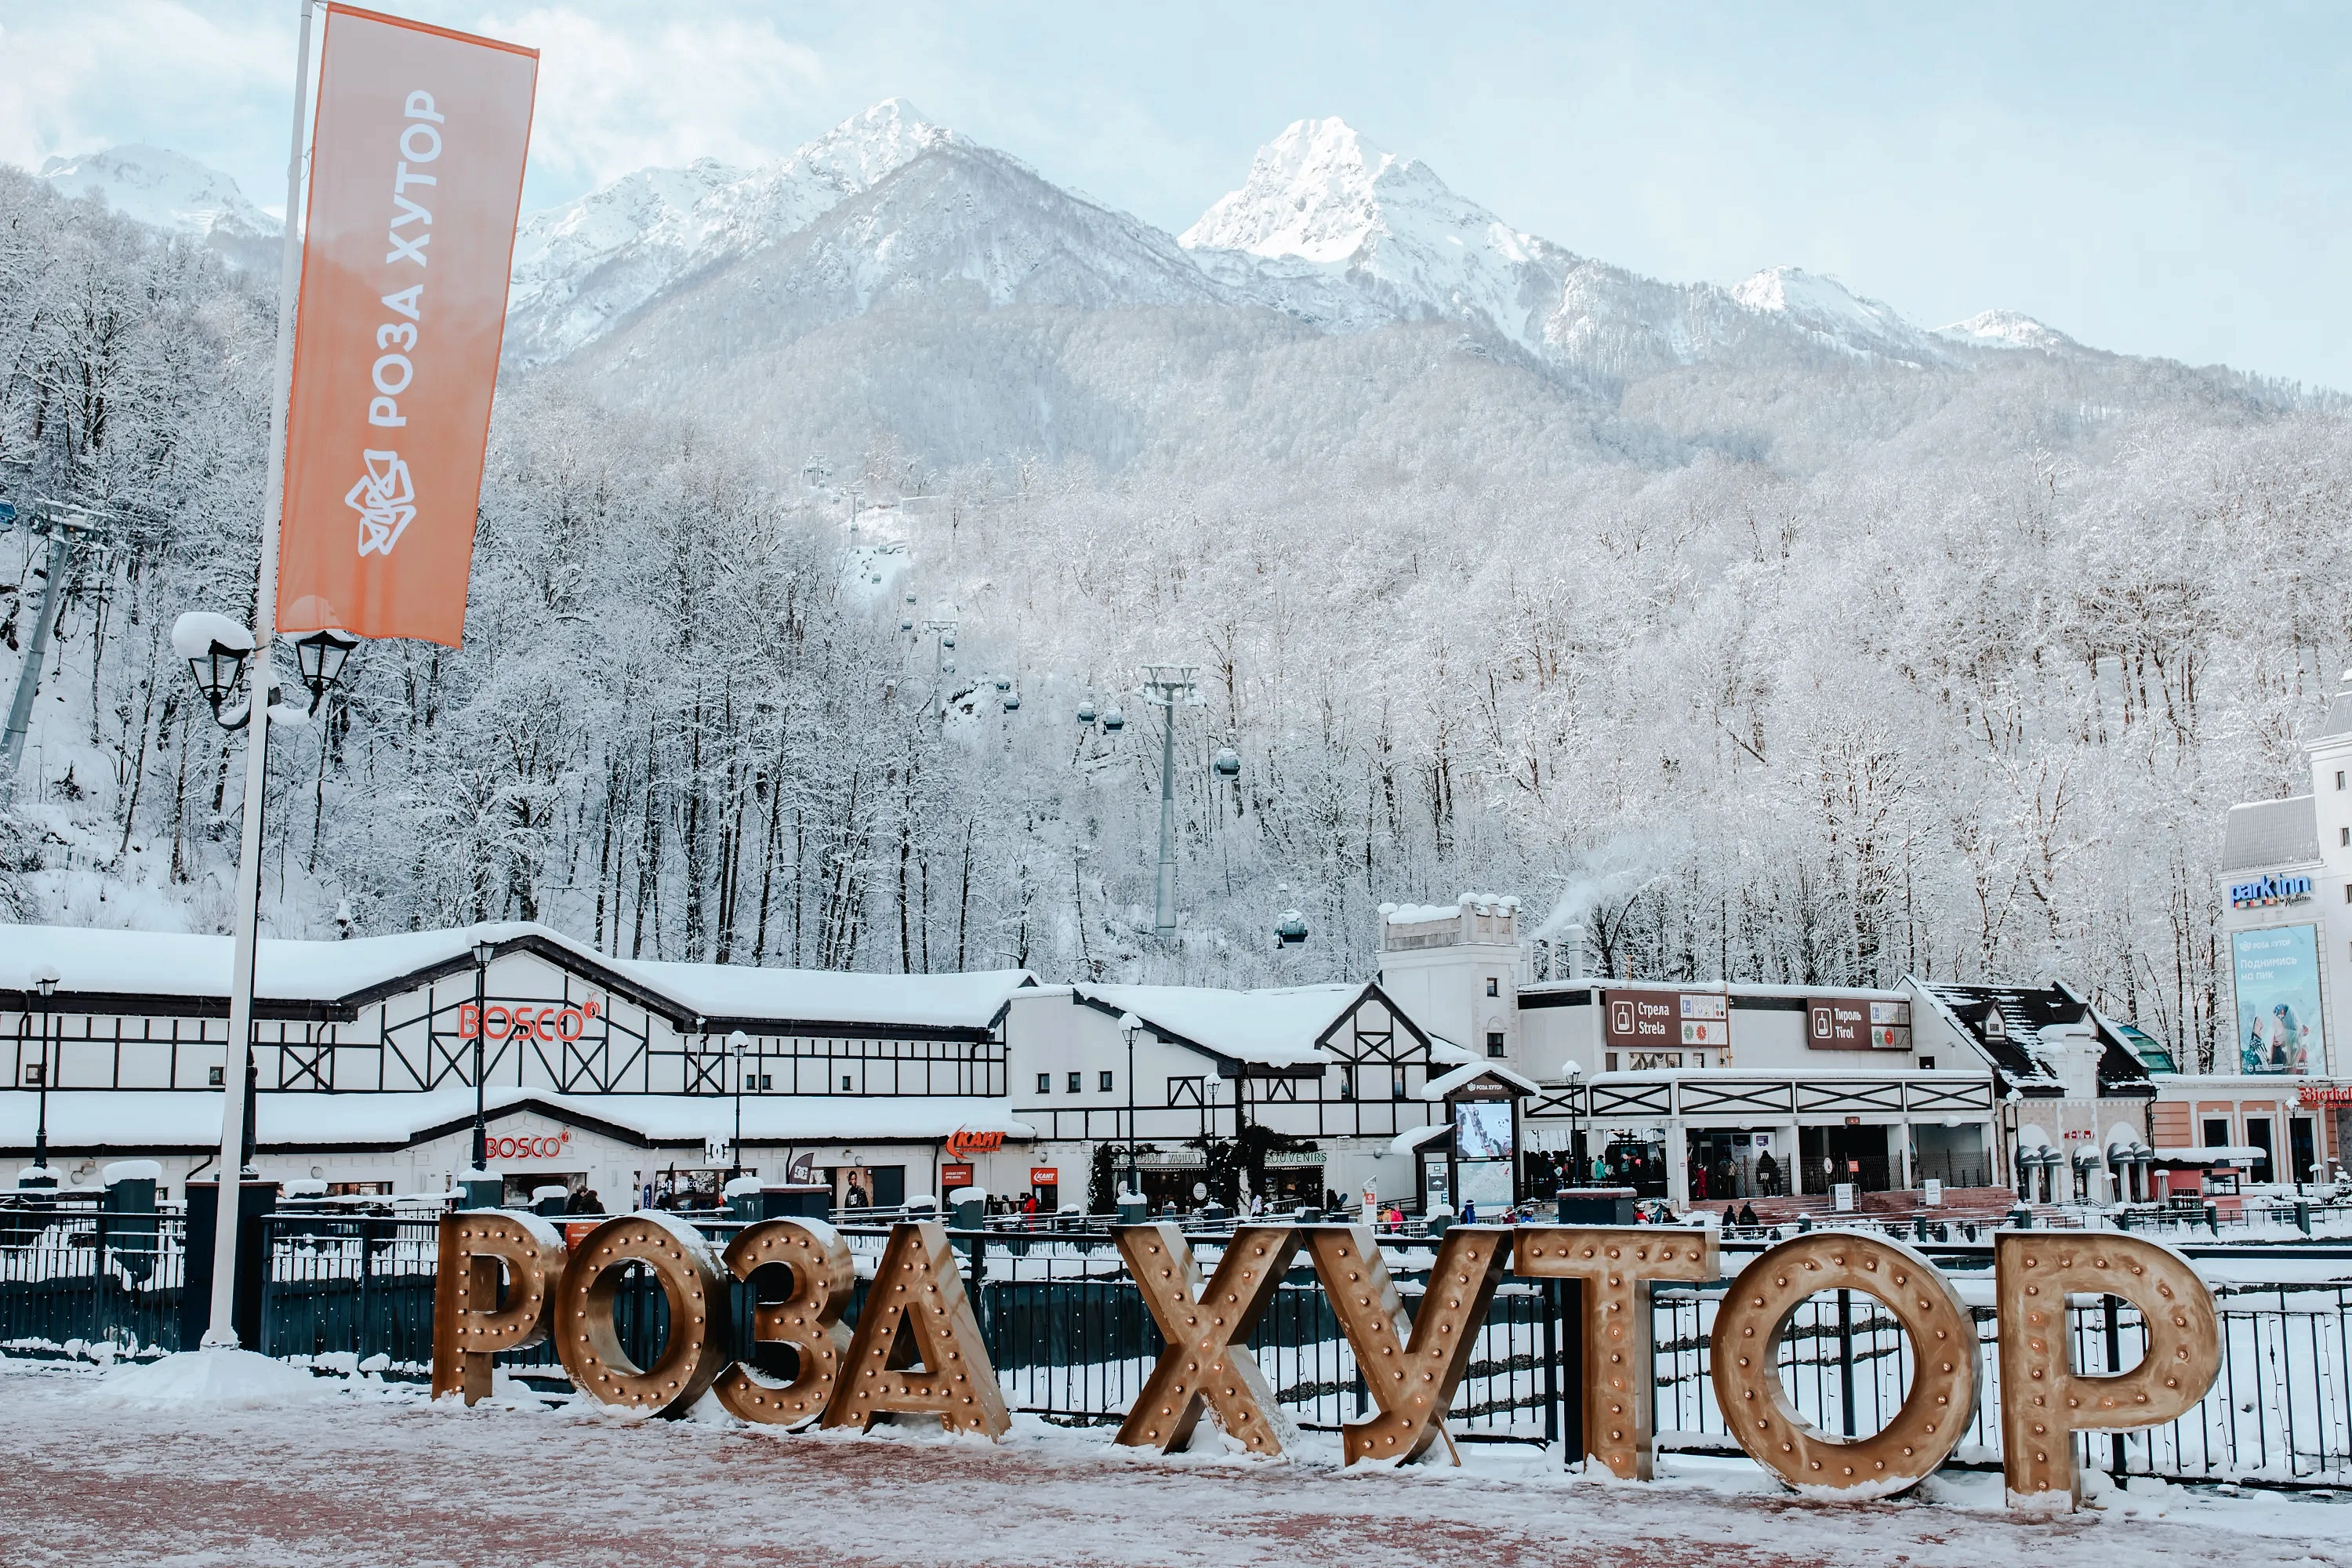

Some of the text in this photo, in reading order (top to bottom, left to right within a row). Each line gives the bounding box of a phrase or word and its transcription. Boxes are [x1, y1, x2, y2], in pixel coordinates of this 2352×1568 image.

[368, 89, 445, 428] РОЗА ХУТОР
[2229, 873, 2311, 909] park inn
[1637, 1001, 1670, 1018] Стрела
[1834, 1007, 1862, 1024] Тироль
[458, 1004, 583, 1042] BOSCO
[1638, 1021, 1666, 1035] Strela
[1835, 1026, 1855, 1039] Tirol
[956, 1131, 1006, 1147] КАНТ
[485, 1137, 561, 1159] BOSCO
[1264, 1152, 1327, 1163] SOUVENIRS
[793, 1165, 809, 1181] DC
[431, 1210, 2223, 1514] РОЗА ХУТОР
